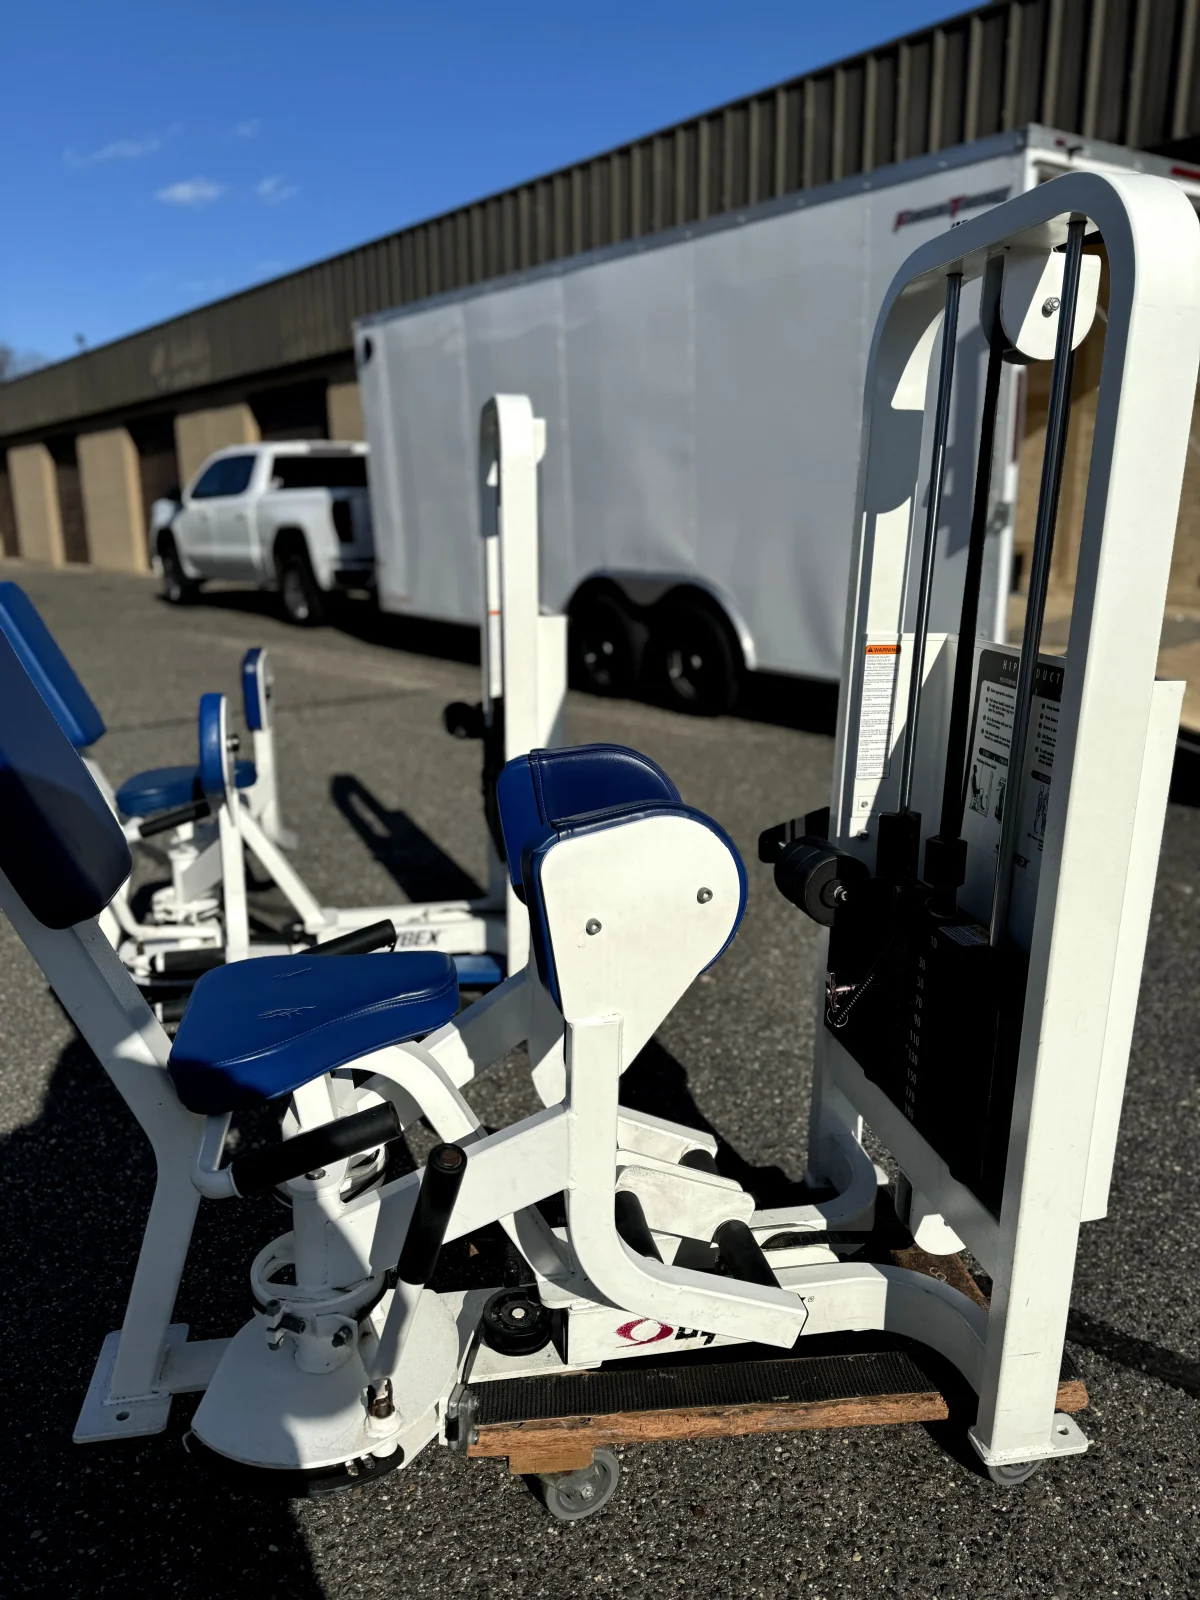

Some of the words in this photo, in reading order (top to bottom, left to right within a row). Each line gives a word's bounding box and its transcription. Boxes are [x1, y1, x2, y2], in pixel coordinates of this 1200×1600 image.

[918, 956, 926, 971] 30
[915, 994, 923, 1009] 70
[909, 1029, 920, 1047] 110
[907, 1067, 917, 1085] 150
